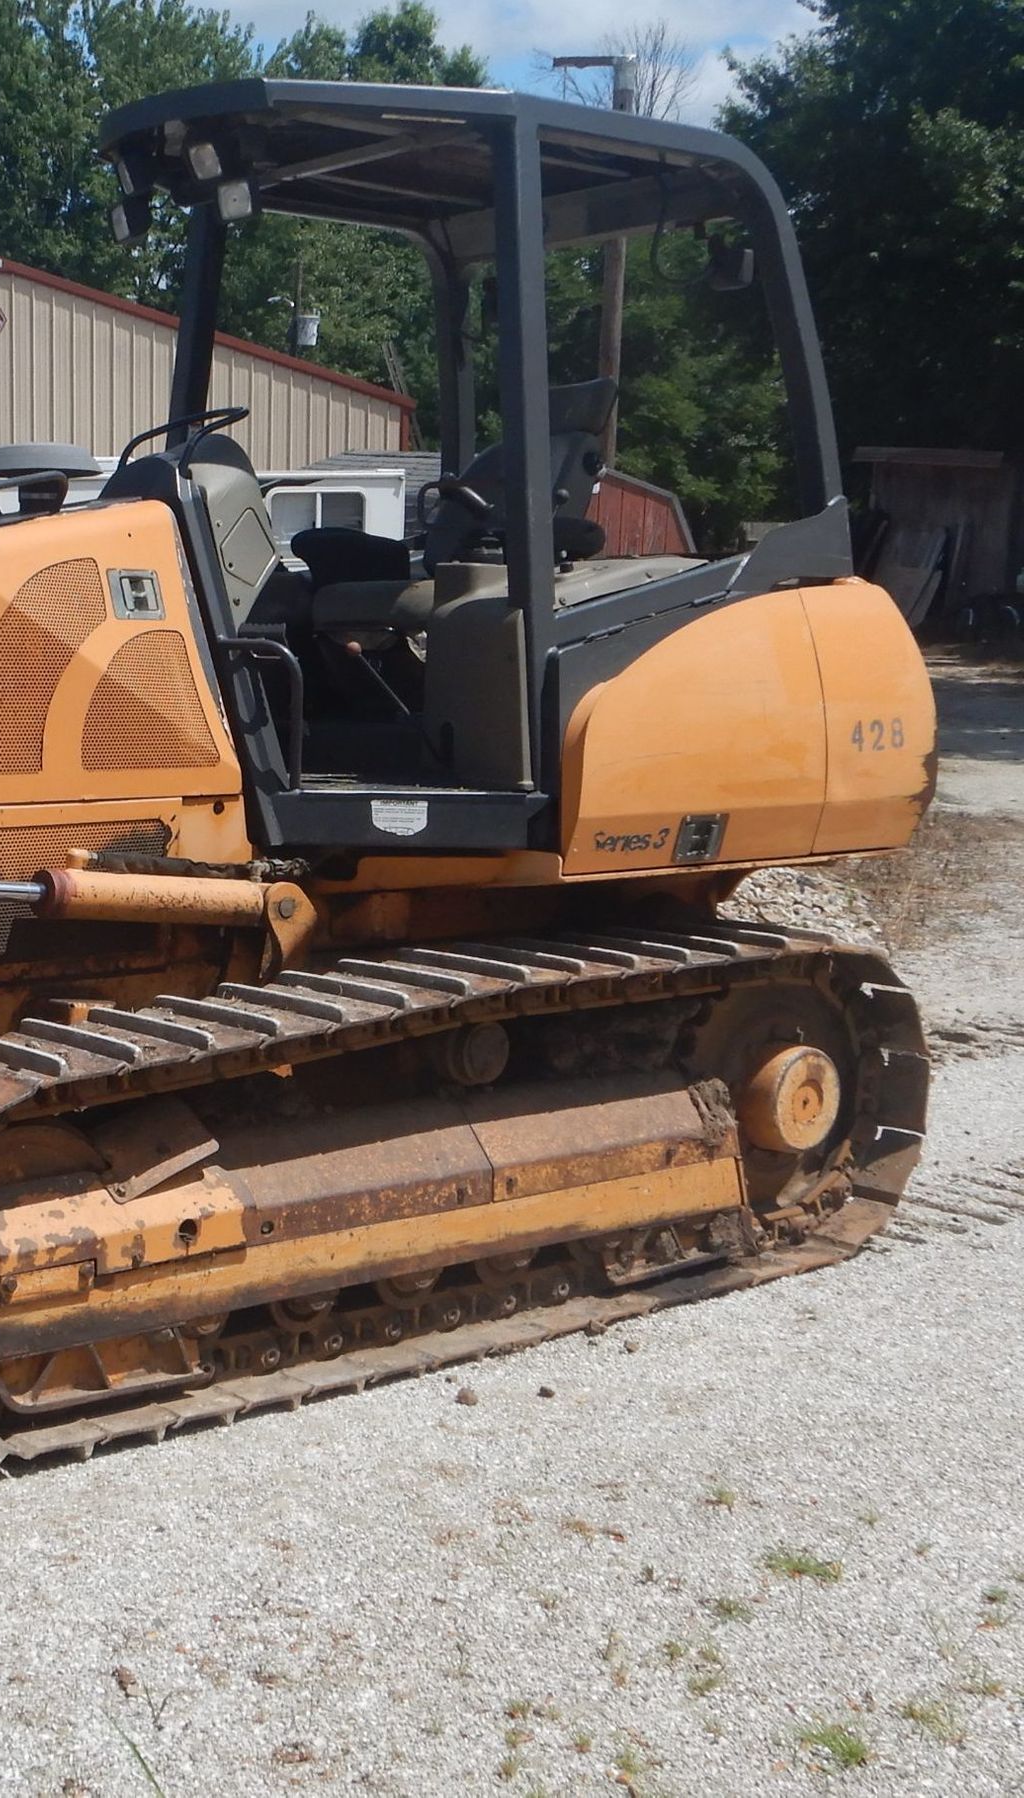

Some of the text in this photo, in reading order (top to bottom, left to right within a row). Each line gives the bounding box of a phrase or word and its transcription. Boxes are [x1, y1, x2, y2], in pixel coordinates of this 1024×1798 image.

[851, 717, 905, 753] 428
[594, 827, 670, 853] Series 3
